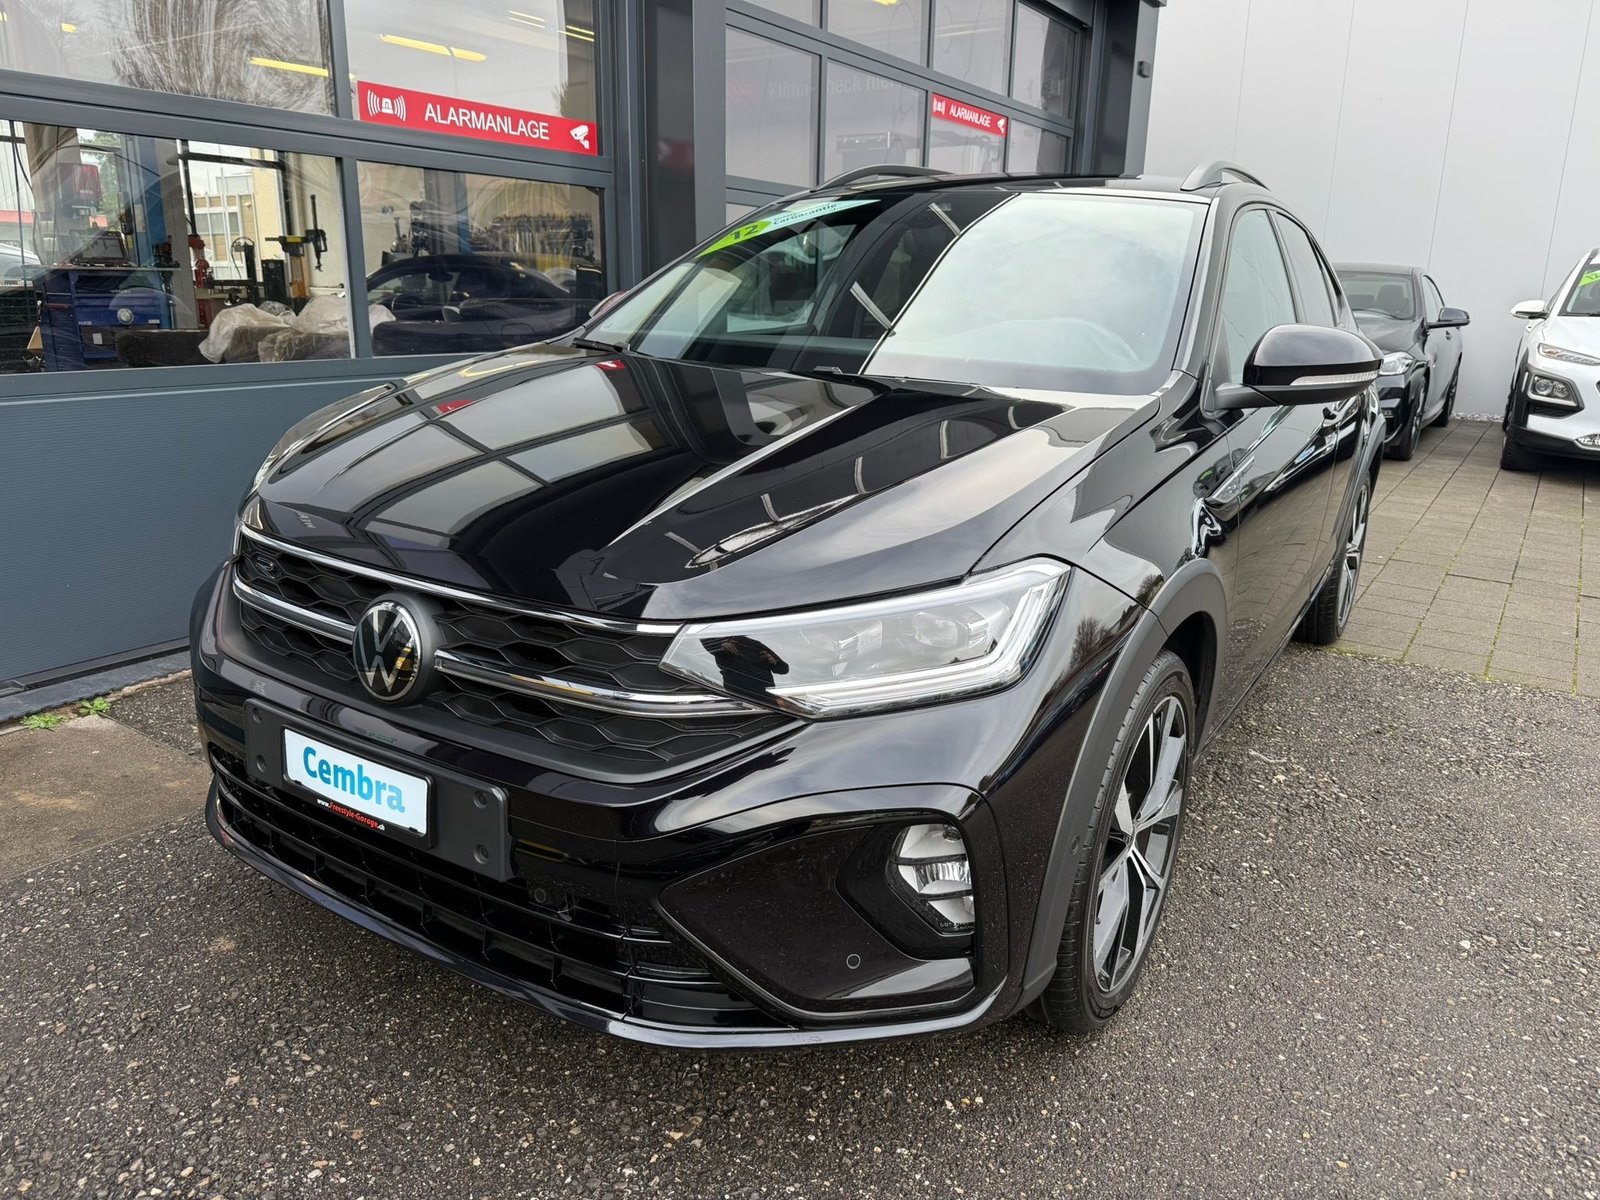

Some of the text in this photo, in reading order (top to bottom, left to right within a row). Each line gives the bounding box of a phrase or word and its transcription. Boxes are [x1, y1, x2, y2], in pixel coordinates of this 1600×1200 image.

[424, 102, 550, 140] ALARMANLAGE
[949, 104, 992, 128] ALARMANLAGE
[729, 224, 760, 240] 12
[302, 746, 406, 814] Cembra
